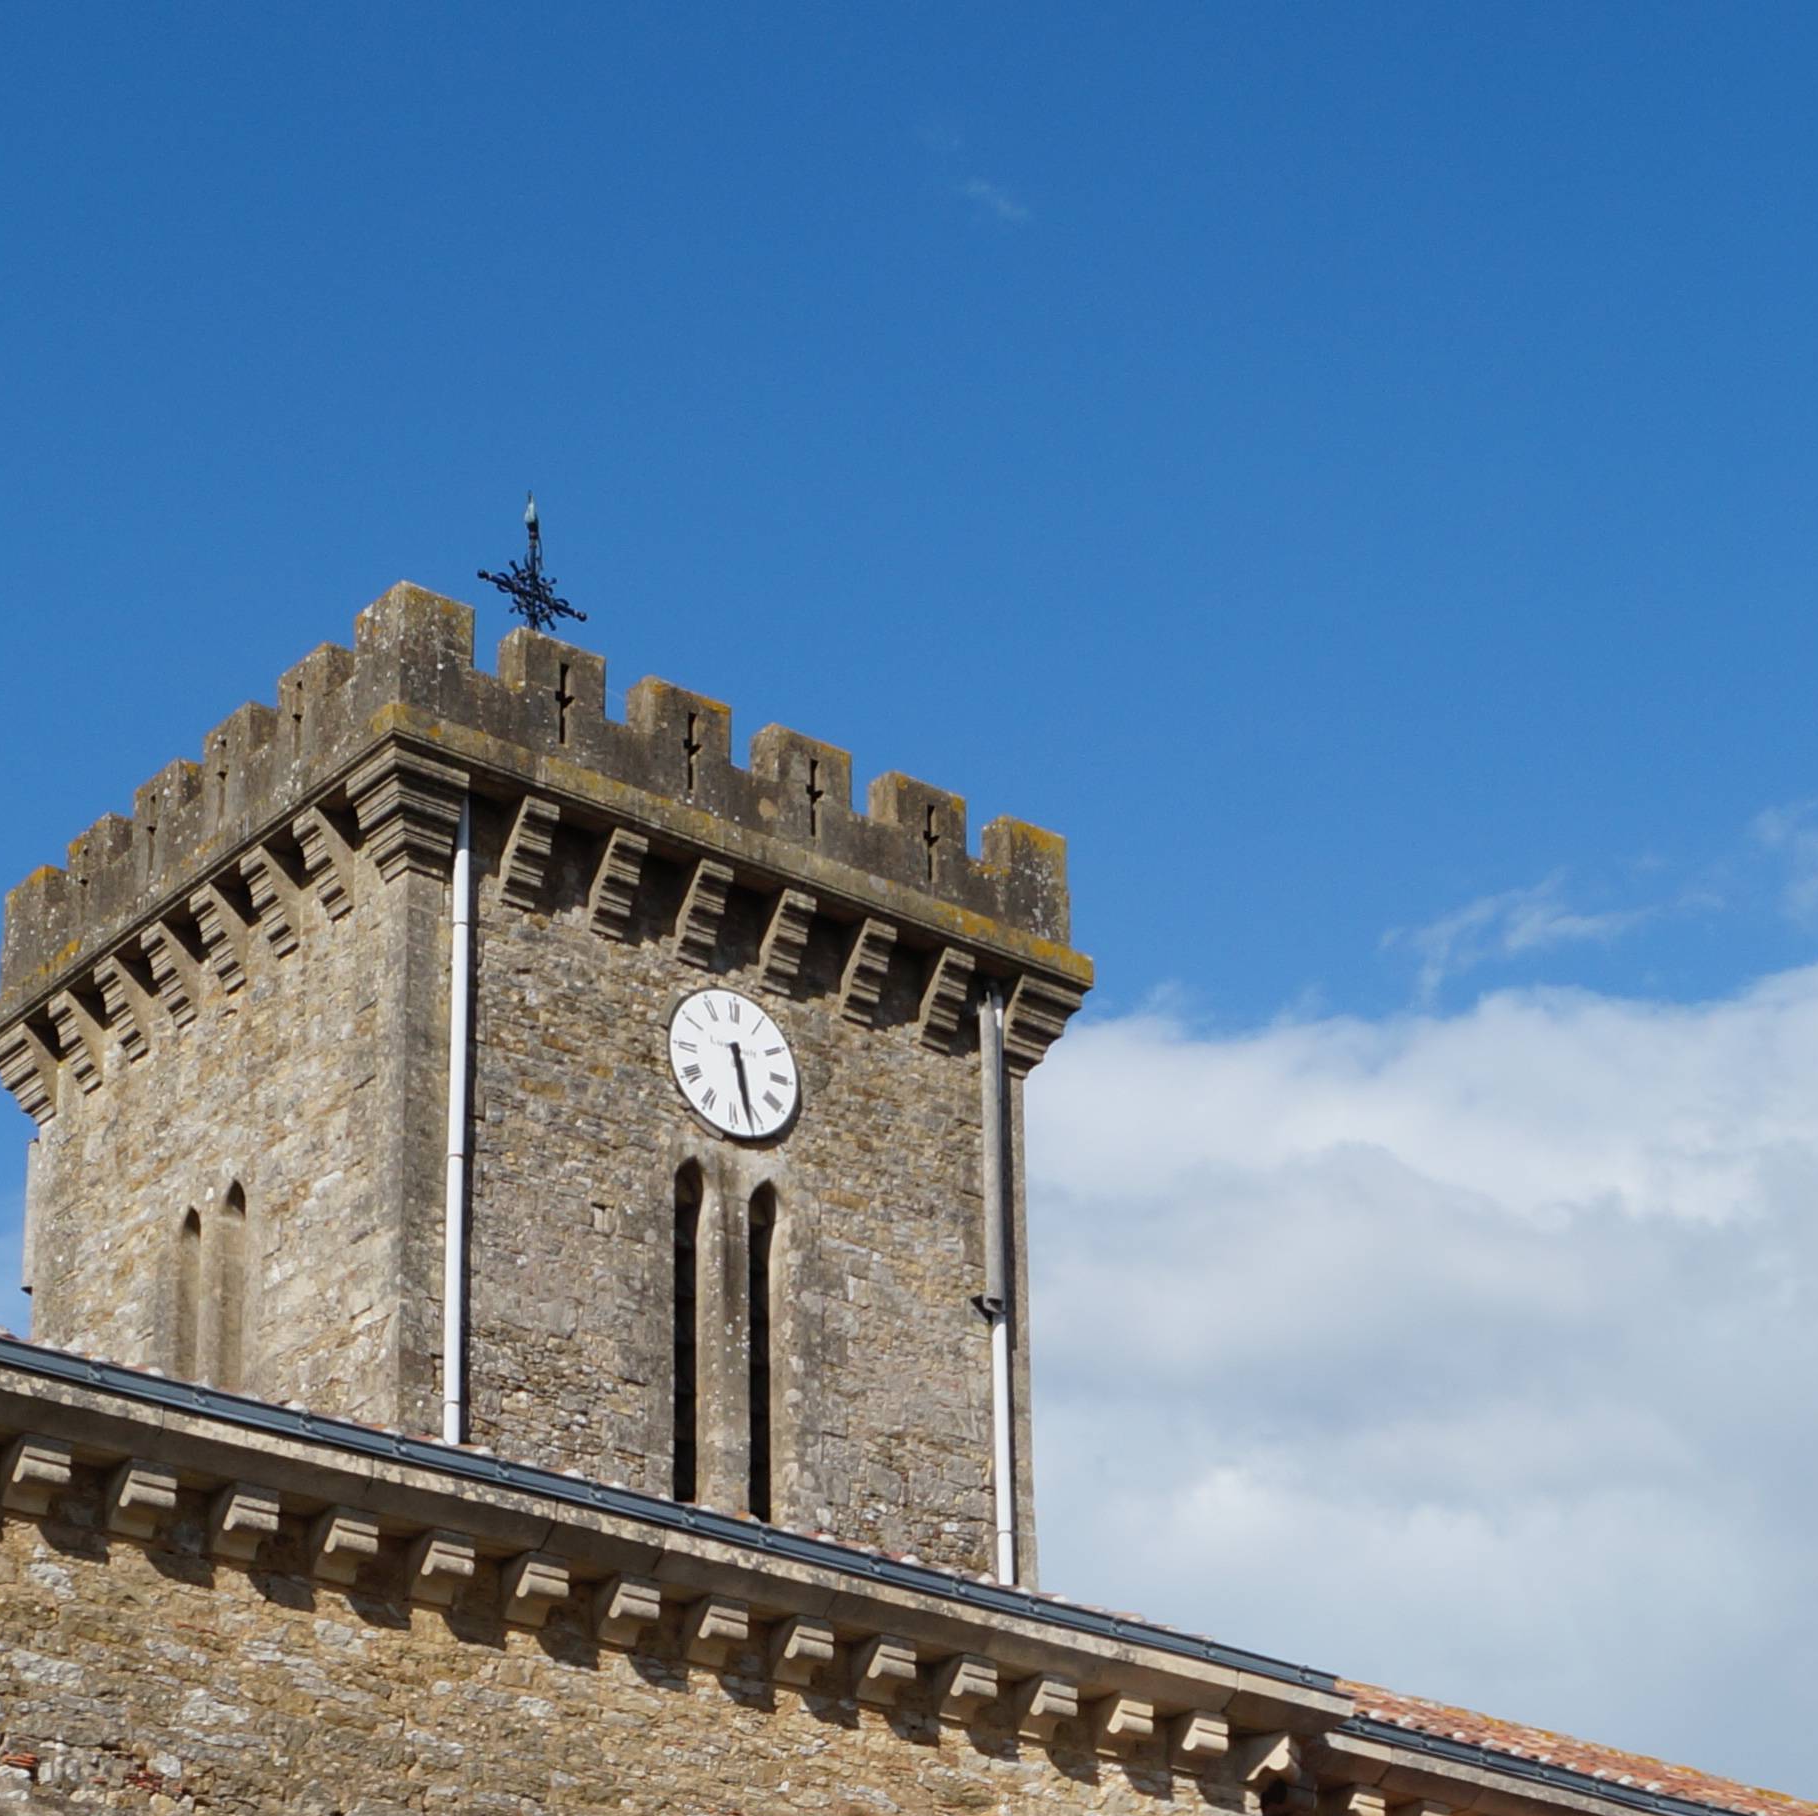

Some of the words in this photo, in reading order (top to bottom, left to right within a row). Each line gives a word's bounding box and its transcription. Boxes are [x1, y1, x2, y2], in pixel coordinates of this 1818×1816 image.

[729, 999, 740, 1024] XII
[751, 1016, 765, 1035] I
[710, 1034, 757, 1059] Lusult
